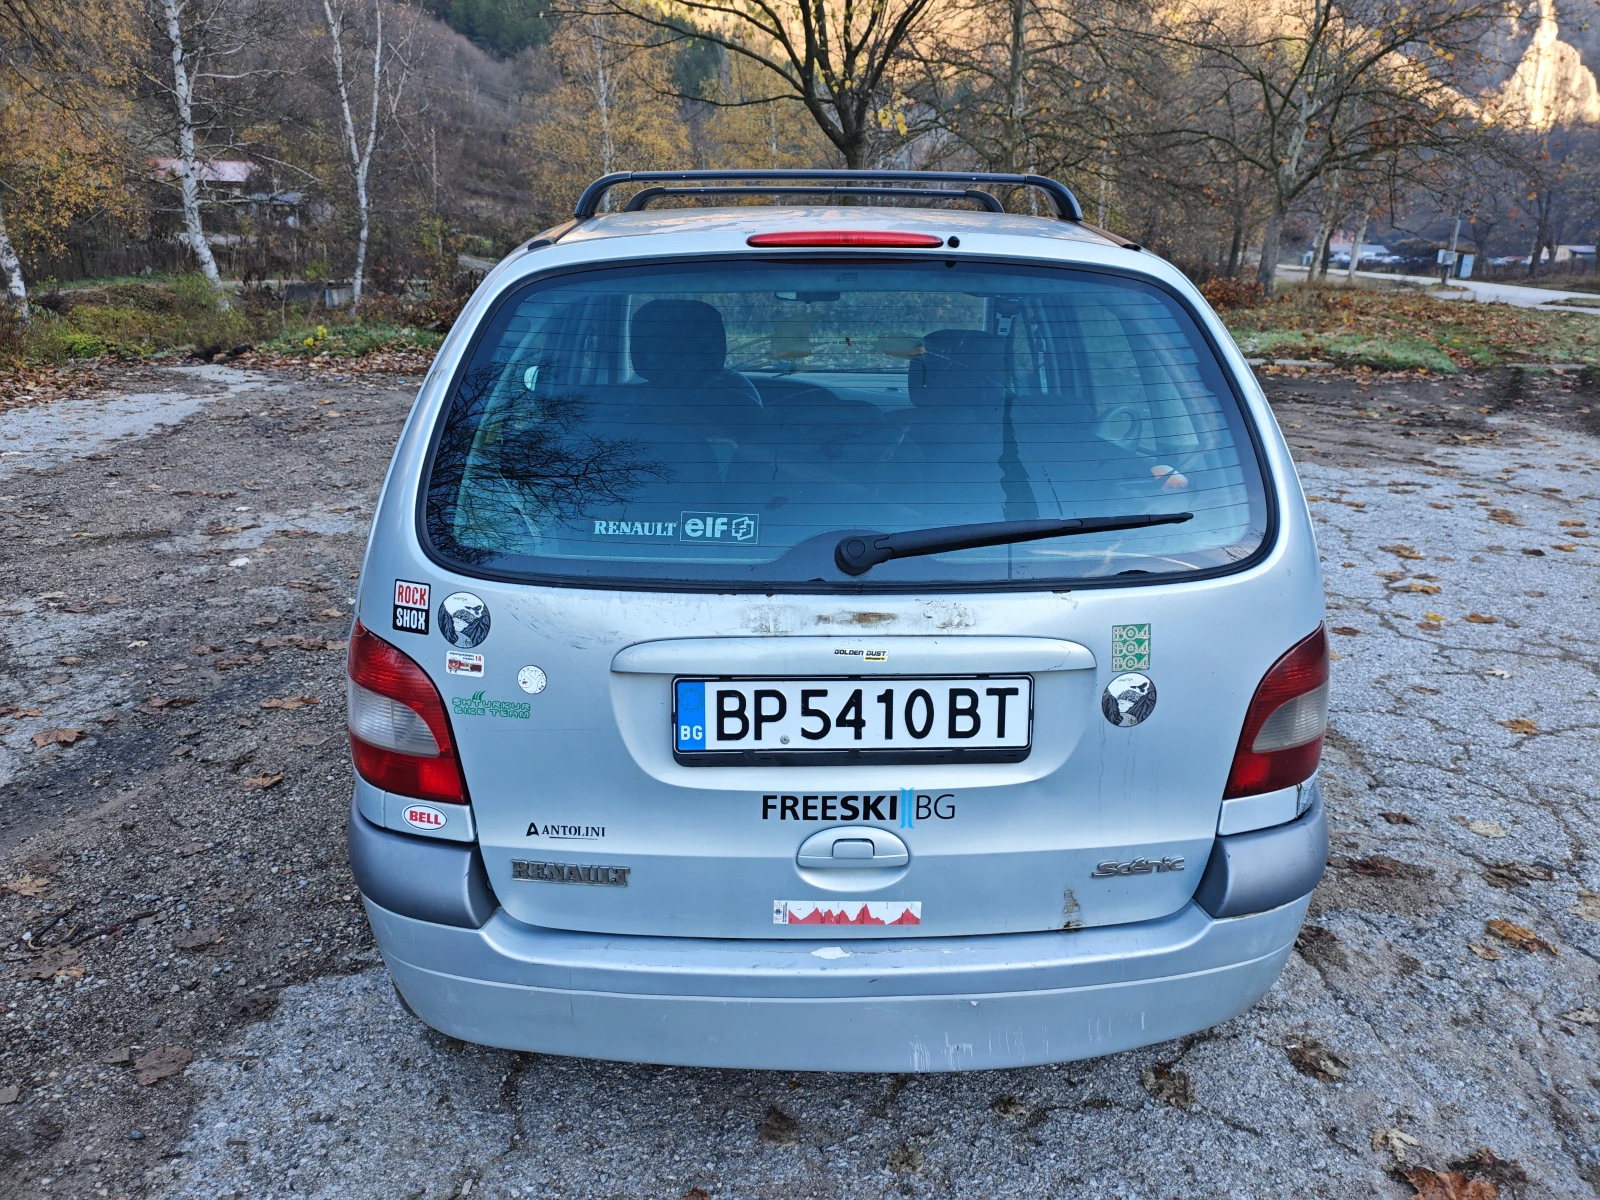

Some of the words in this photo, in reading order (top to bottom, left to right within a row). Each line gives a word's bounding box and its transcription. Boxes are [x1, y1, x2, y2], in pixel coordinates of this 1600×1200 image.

[594, 520, 676, 537] RENAULT
[684, 516, 728, 538] elf
[397, 584, 427, 607] ROCK
[396, 607, 426, 631] SHOX
[452, 697, 531, 712] SHTURKUR
[454, 706, 486, 716] BIKE
[489, 708, 530, 719] TEAM
[716, 689, 787, 741] BP
[800, 688, 935, 740] 5410
[949, 687, 1019, 739] BT
[680, 725, 703, 741] BG
[409, 810, 442, 826] BELL
[762, 795, 898, 821] FREESKI
[915, 794, 956, 821] BG
[541, 824, 606, 838] ANTOLINI
[511, 859, 631, 887] RENAULT
